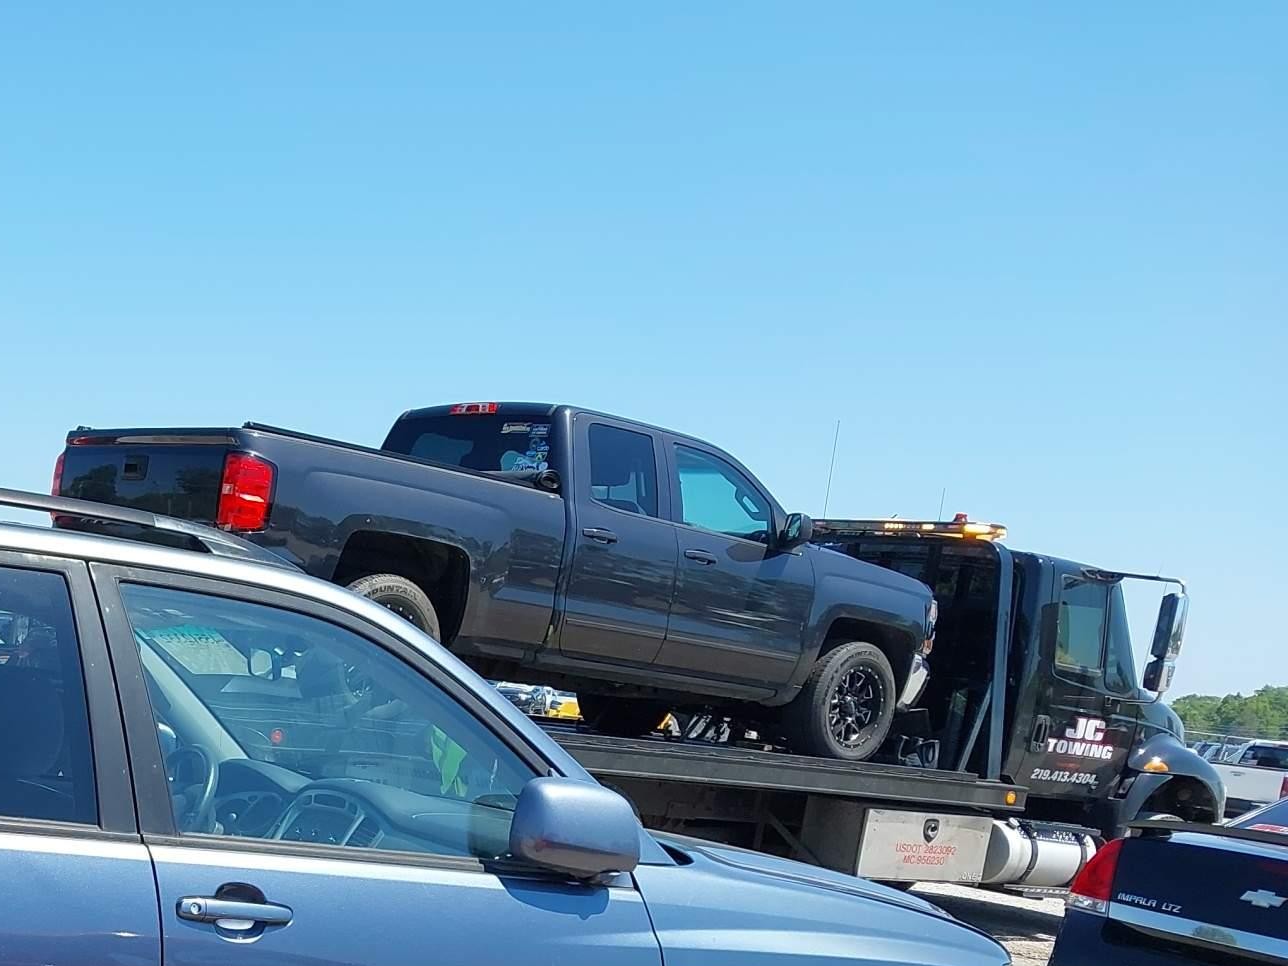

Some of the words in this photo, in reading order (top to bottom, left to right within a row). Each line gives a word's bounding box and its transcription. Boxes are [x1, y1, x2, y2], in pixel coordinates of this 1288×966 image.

[1065, 718, 1106, 741] JC
[1047, 738, 1114, 760] TOWING
[1030, 768, 1097, 785] 219.413.4304
[896, 843, 922, 855] USDOT
[1117, 892, 1157, 907] IMPALA
[1161, 902, 1183, 913] LTZ
